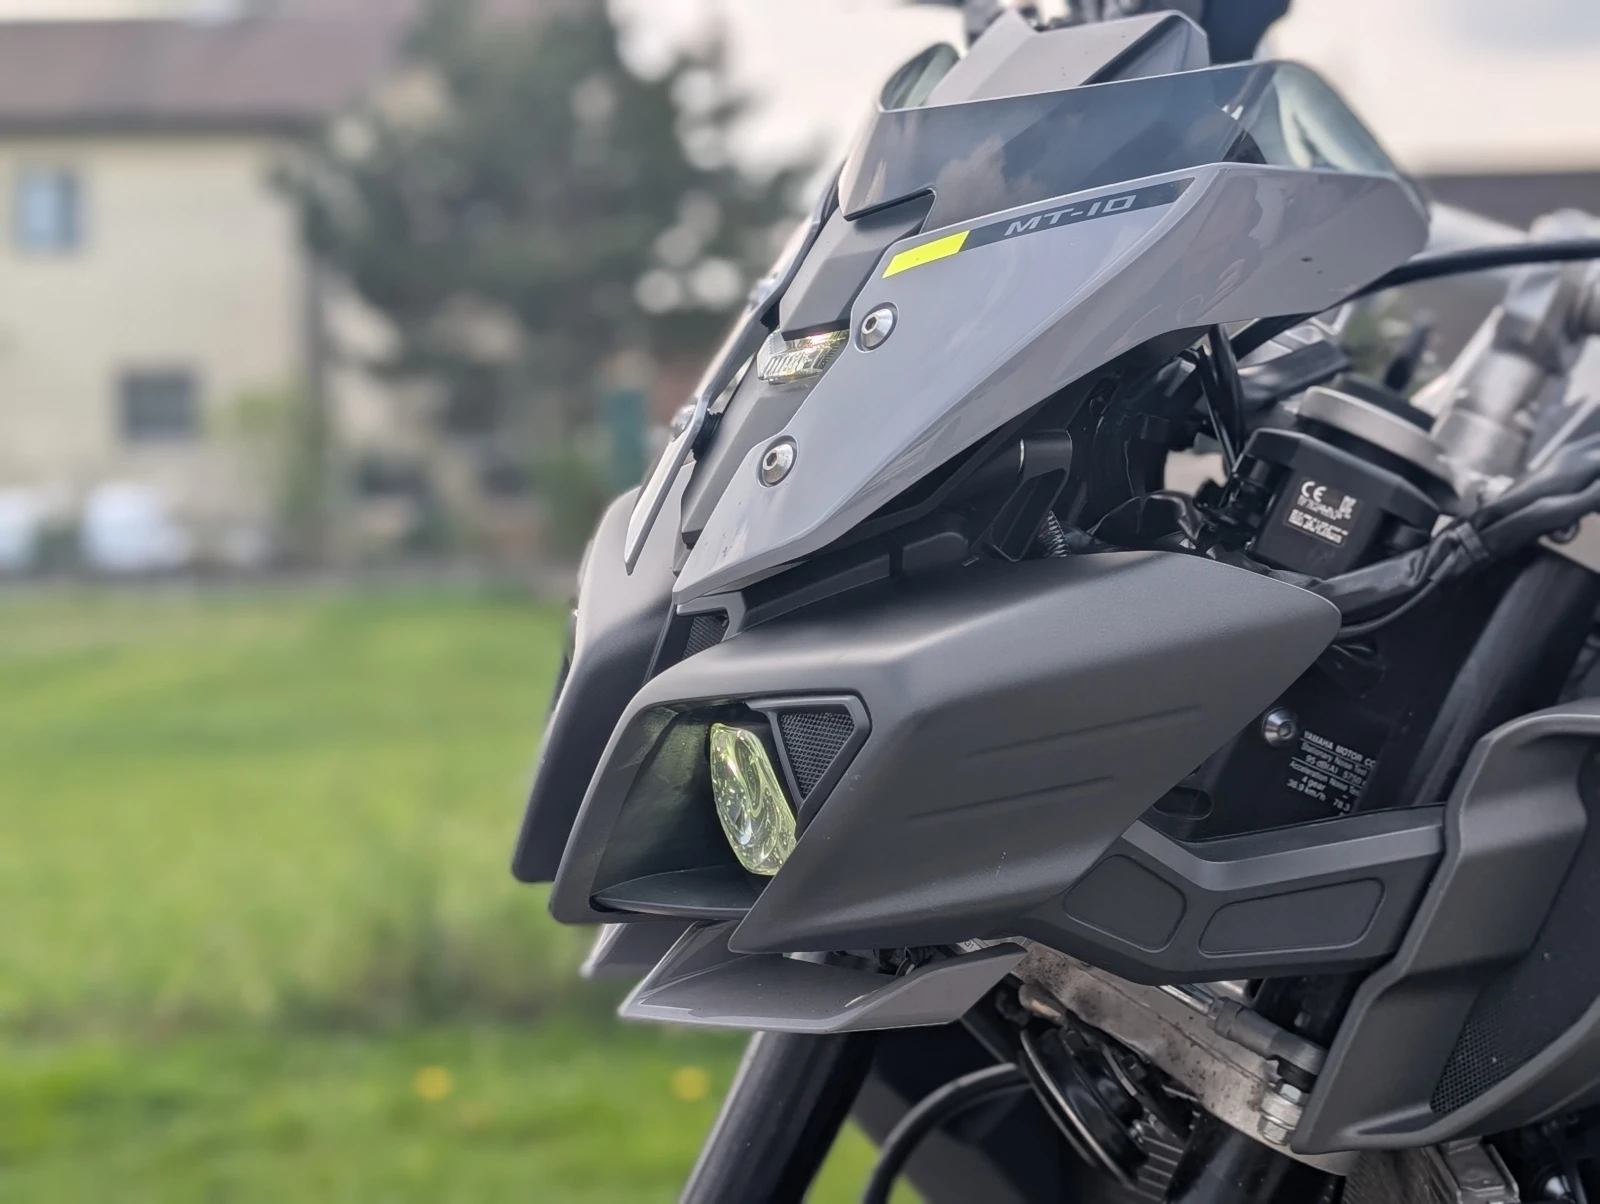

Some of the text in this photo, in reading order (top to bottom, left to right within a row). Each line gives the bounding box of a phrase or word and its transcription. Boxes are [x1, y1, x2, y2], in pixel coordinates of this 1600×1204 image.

[1003, 194, 1137, 236] MT-10
[1301, 481, 1327, 503] CE
[1304, 731, 1333, 750] YAMAHA
[1335, 745, 1363, 762] MOTOR
